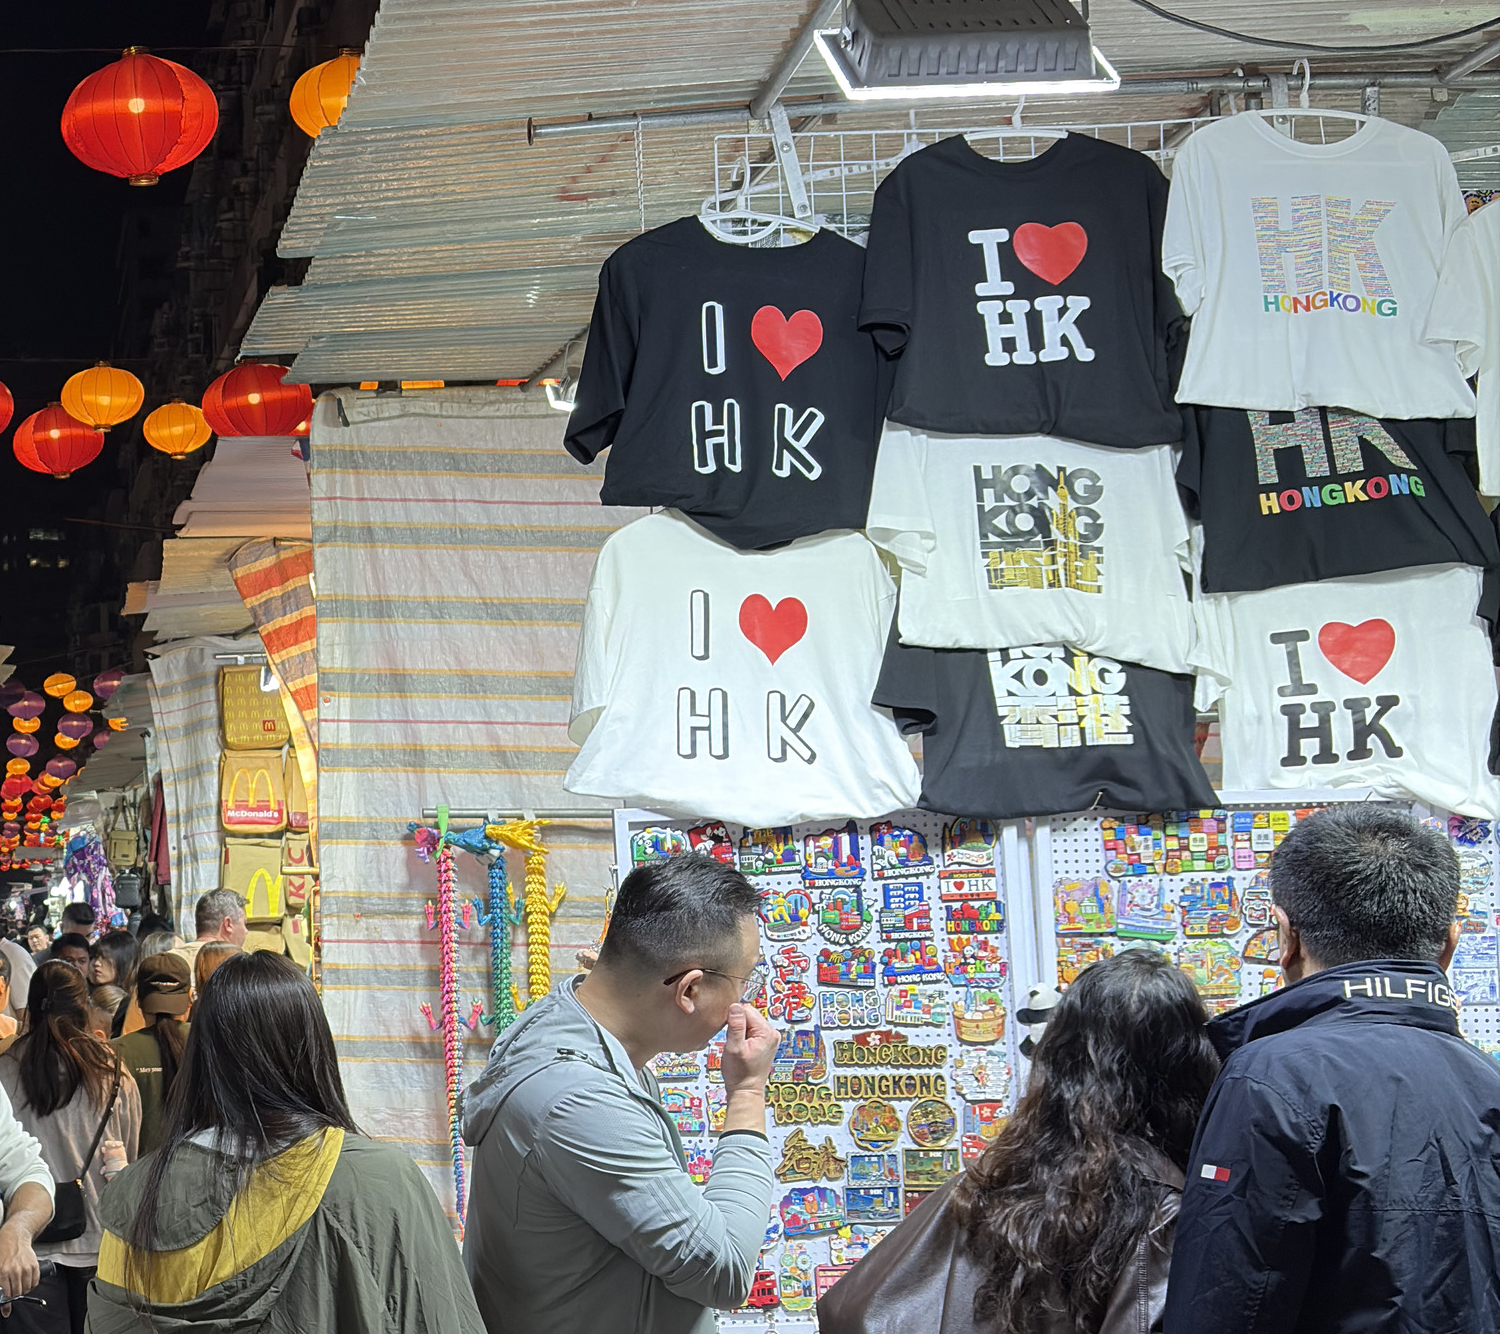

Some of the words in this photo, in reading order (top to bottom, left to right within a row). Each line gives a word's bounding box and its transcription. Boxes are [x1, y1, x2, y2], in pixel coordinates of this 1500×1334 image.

[1251, 195, 1397, 297] HK
[968, 228, 1016, 297] I
[1263, 290, 1398, 317] HONGKONG
[702, 301, 723, 375] I
[976, 296, 1095, 367] HK
[973, 463, 1103, 505] HONG
[1259, 474, 1426, 515] HONGKONG
[690, 589, 710, 661] I
[1270, 629, 1319, 697] I
[1279, 694, 1403, 767] HK
[227, 810, 279, 818] McDonald's
[288, 847, 306, 899] KC
[815, 878, 862, 886] HONGKONG
[884, 865, 935, 878] HONGKONG
[968, 879, 993, 892] HK
[819, 923, 846, 945] HONG
[848, 921, 872, 945] KONG
[891, 931, 934, 939] HONGKONG
[947, 920, 1005, 932] HONGKONG
[898, 974, 921, 984] HONG
[922, 972, 945, 982] KONG
[821, 990, 880, 1008] HONG
[822, 1008, 880, 1026] KONG
[834, 1041, 947, 1065] HONGKONG
[765, 1084, 833, 1104] HONG
[835, 1074, 947, 1098] HONGKONG
[775, 1103, 844, 1124] KONG
